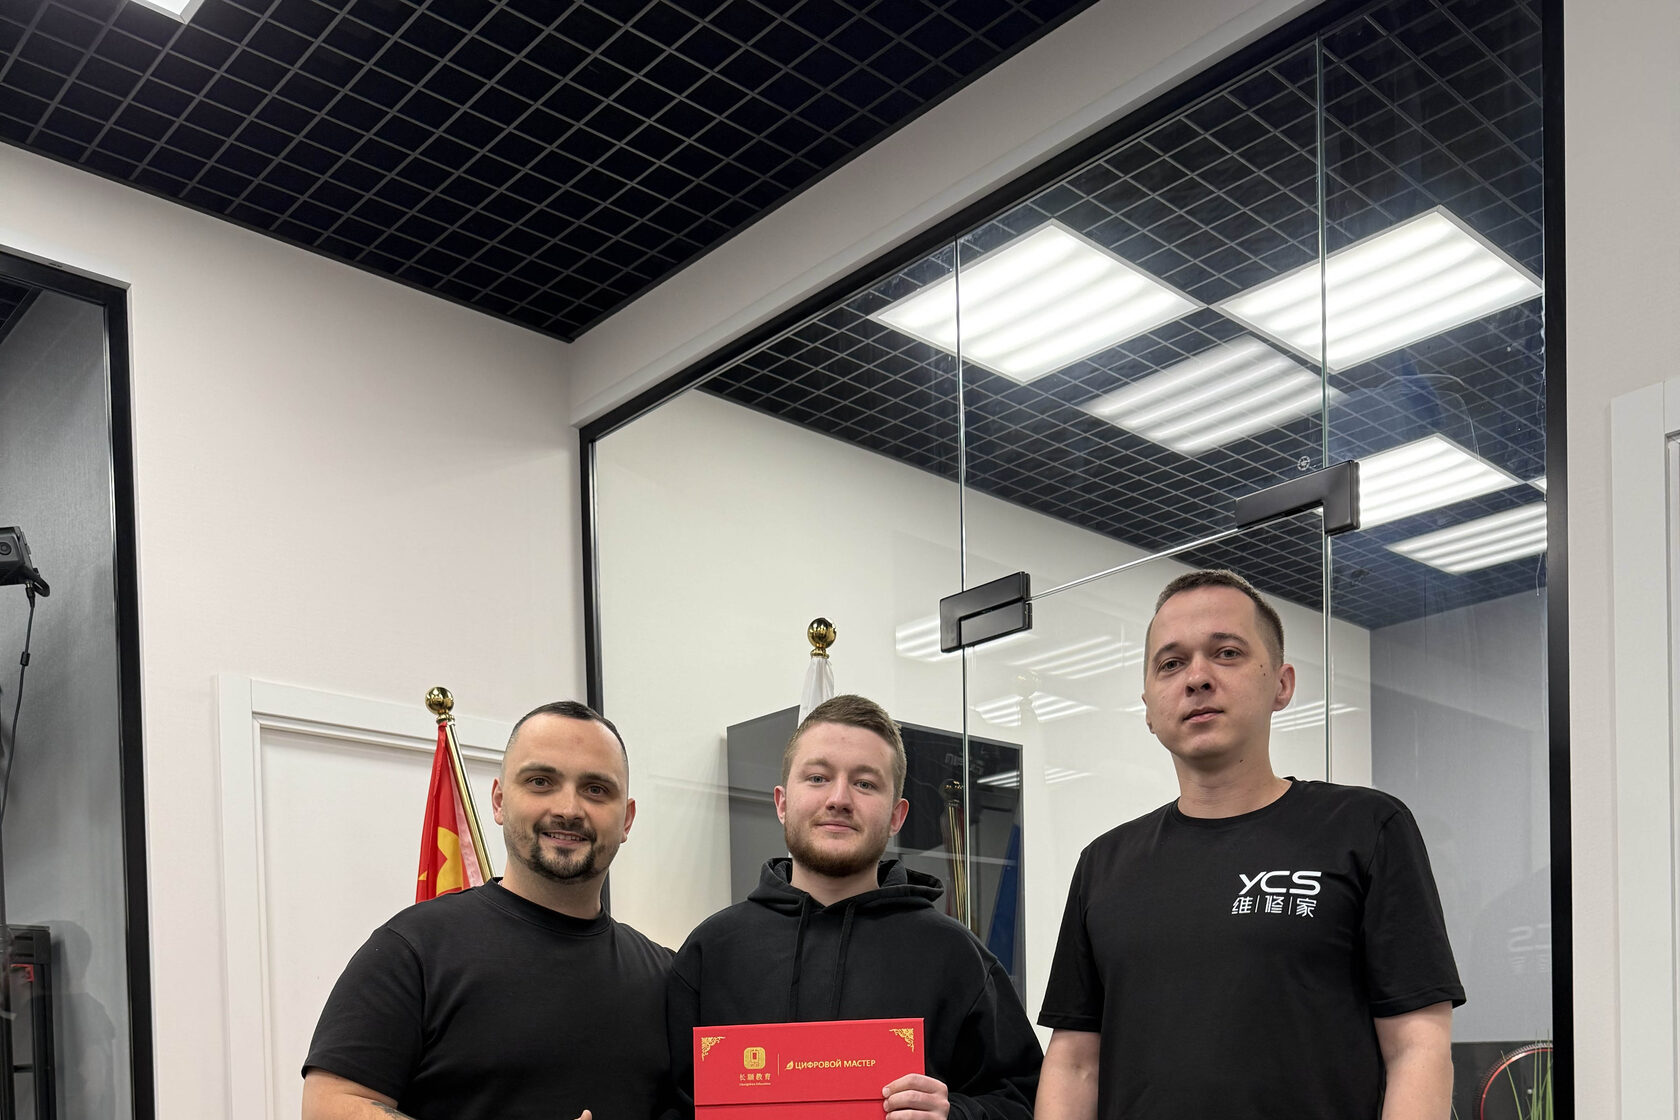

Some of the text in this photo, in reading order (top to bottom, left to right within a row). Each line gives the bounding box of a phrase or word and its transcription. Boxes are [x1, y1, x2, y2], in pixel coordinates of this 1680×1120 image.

[1238, 870, 1322, 896] YCS
[795, 1059, 876, 1070] ЦИФРОВОЙ МАСТЕР
